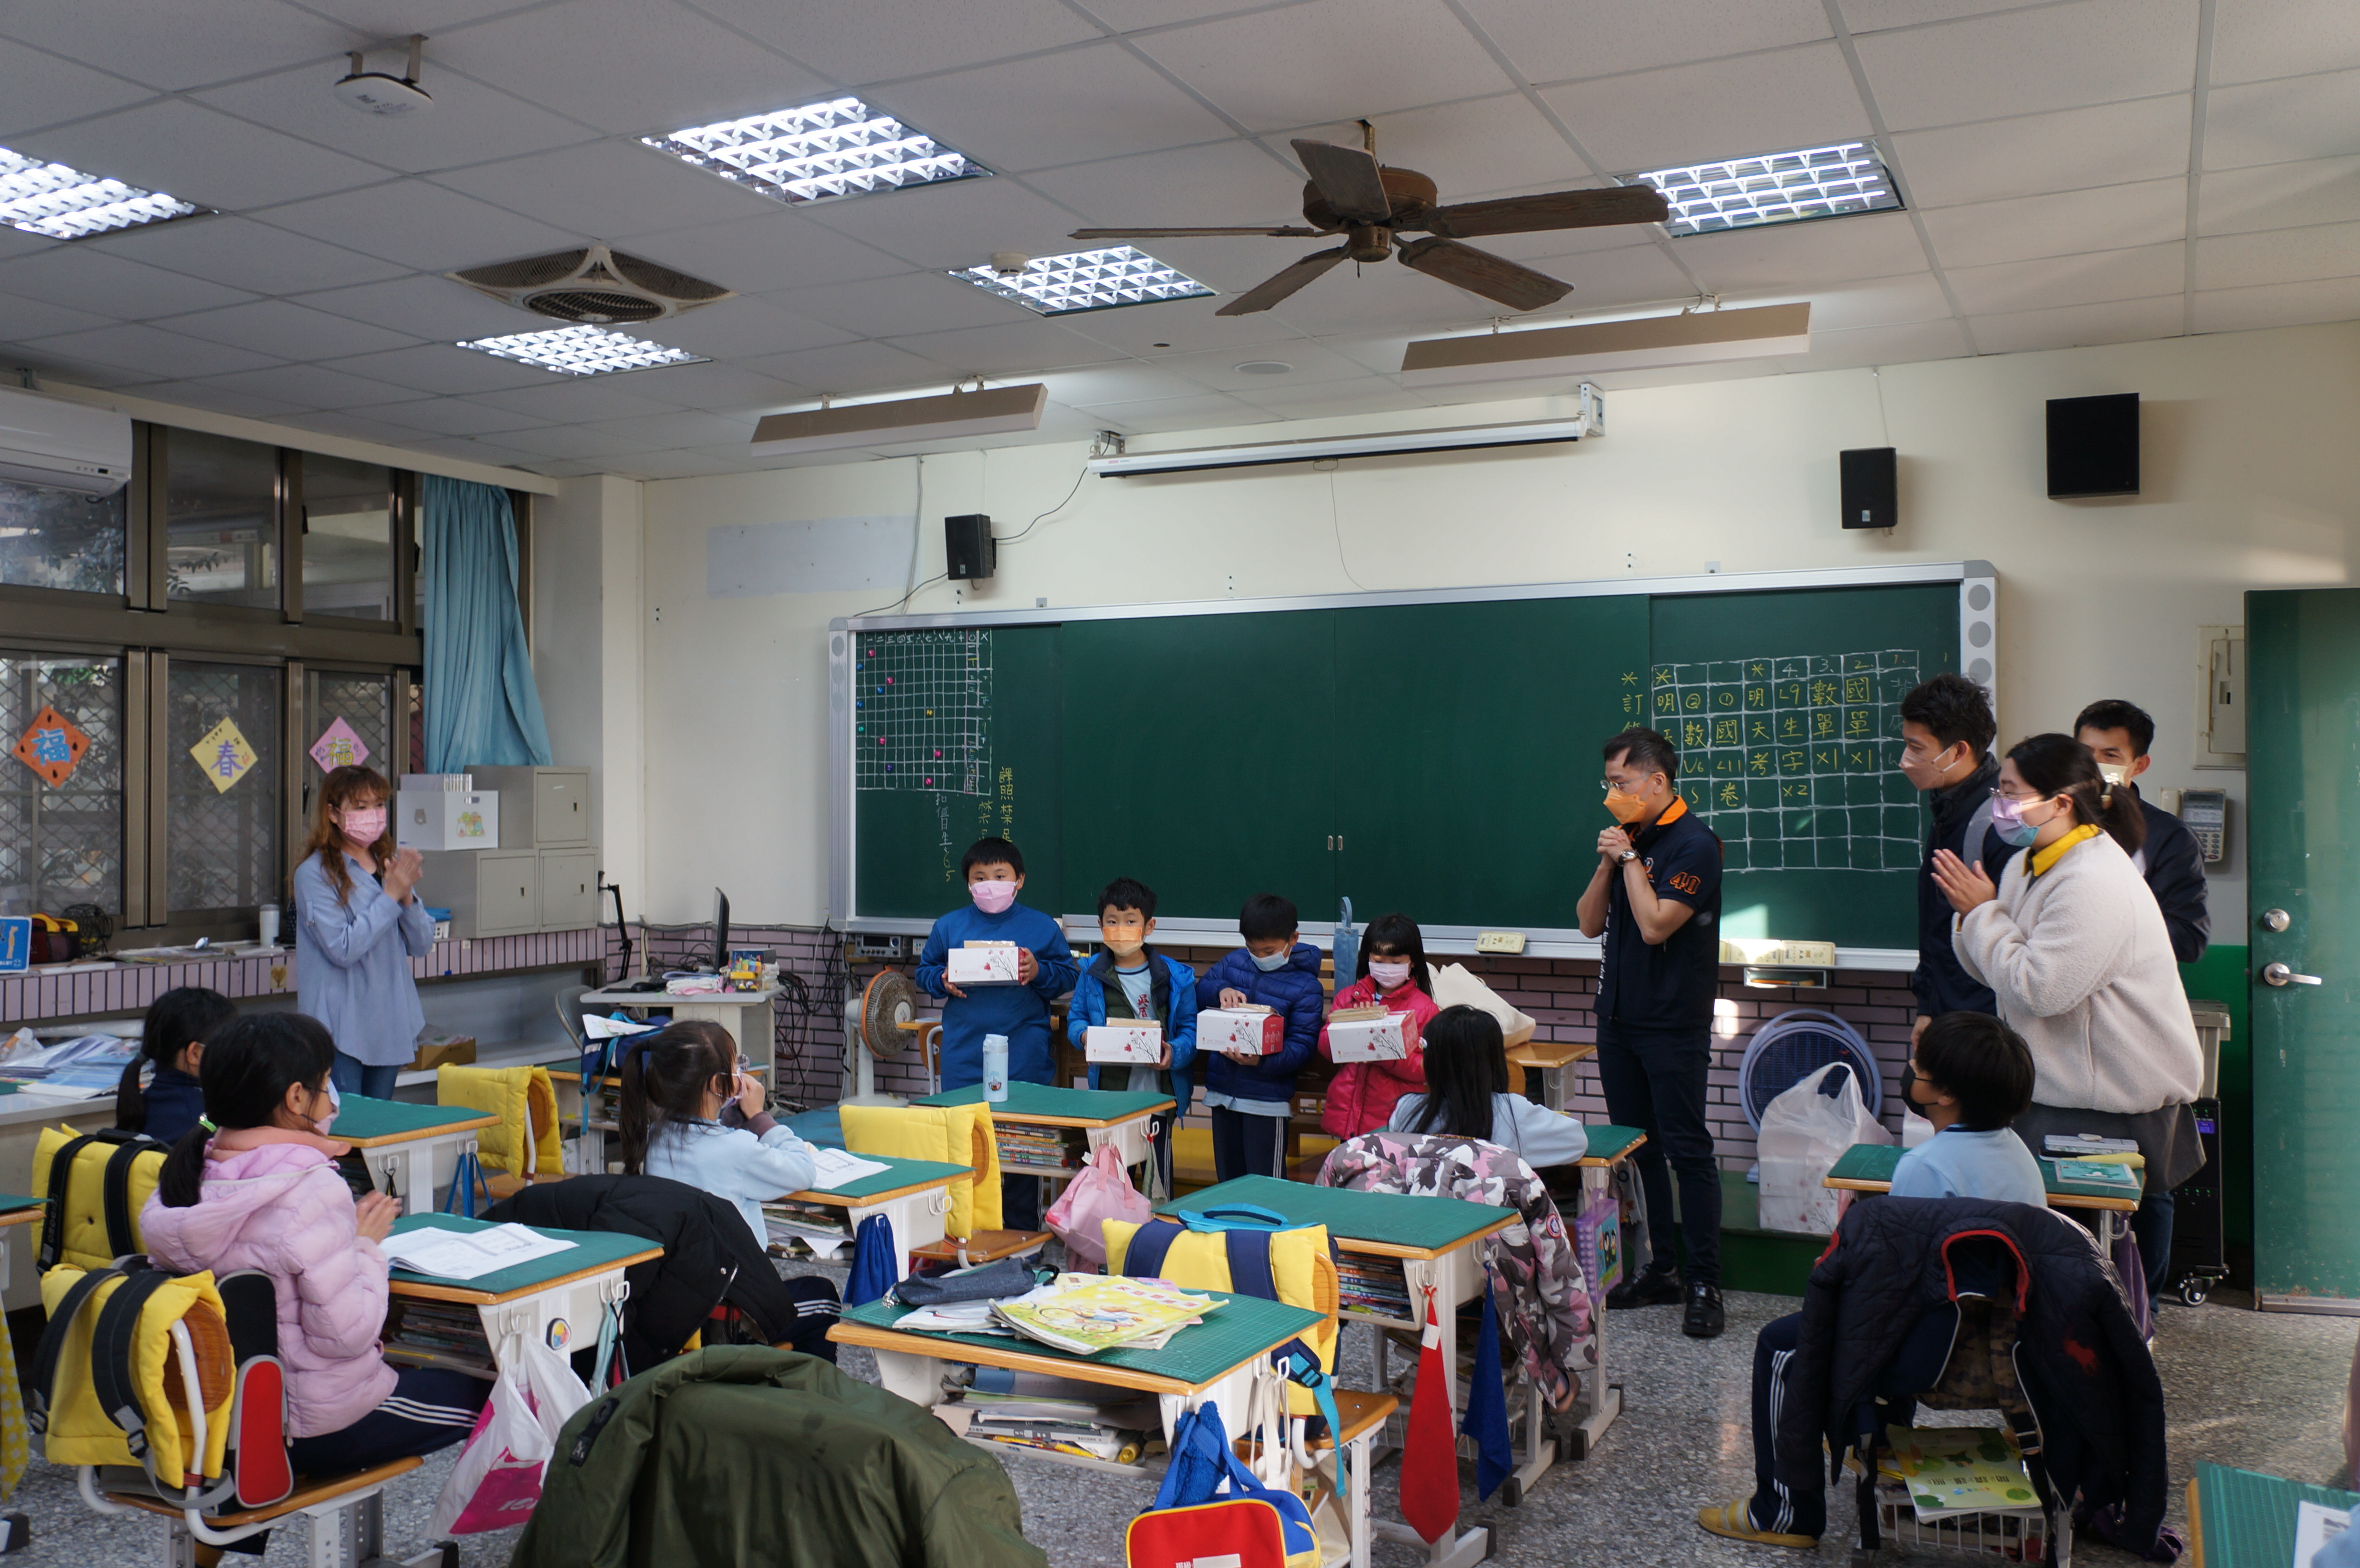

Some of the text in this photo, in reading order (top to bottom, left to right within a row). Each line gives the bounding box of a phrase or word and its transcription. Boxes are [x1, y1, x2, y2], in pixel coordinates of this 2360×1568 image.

[897, 635, 906, 644] 四
[906, 634, 914, 644] 五
[915, 634, 923, 644] 六
[925, 634, 933, 643] 七
[945, 632, 954, 643] 九
[958, 630, 965, 643] 十
[31, 728, 71, 767] 福
[210, 740, 244, 779] 春
[326, 735, 354, 768] 福
[1670, 871, 1701, 894] 40
